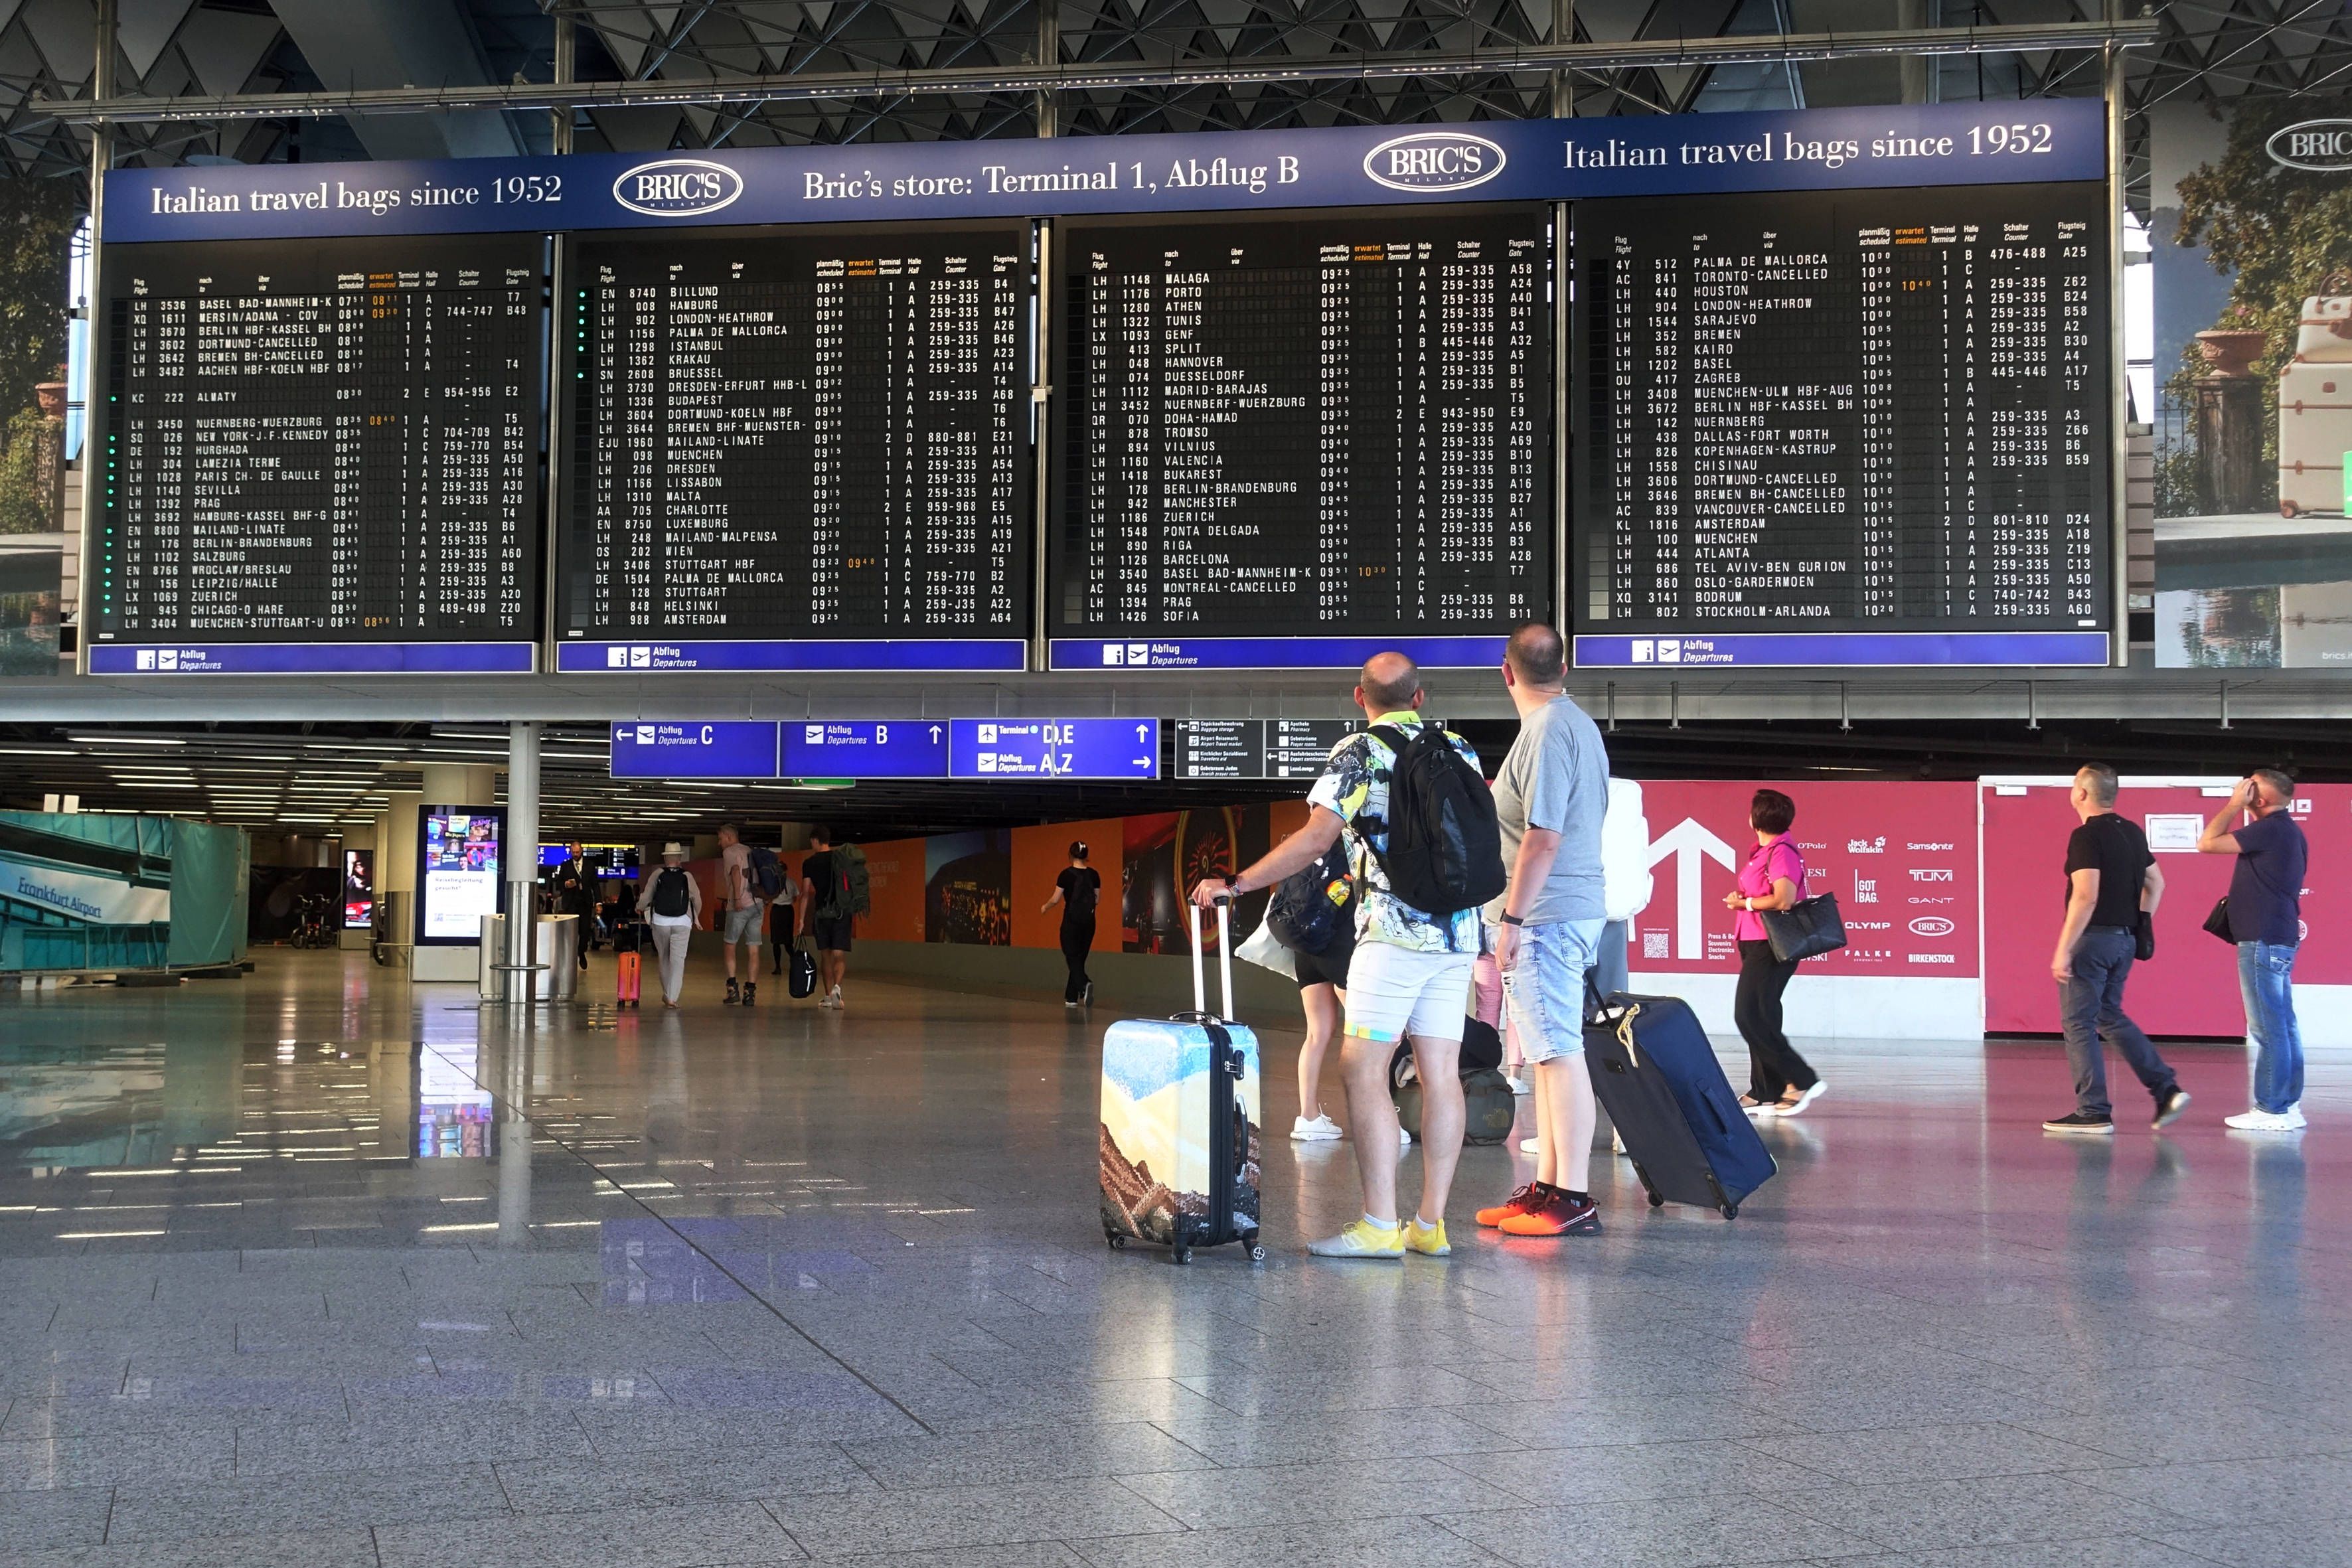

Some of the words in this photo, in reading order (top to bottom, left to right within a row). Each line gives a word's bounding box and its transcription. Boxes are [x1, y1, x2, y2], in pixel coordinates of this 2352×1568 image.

[1563, 139, 1667, 169] Italian
[1679, 132, 1774, 165] travel
[1784, 131, 1859, 169] bags
[1872, 130, 1953, 158] since
[1967, 123, 2052, 155] 1952
[2289, 132, 2352, 157] BRIC
[1388, 146, 1482, 176] BRIC'S
[894, 175, 972, 196] store:
[982, 161, 1118, 193] Terminal
[1131, 161, 1156, 195] 1,
[1164, 157, 1268, 194] Abflug
[1277, 156, 1299, 183] B
[1403, 175, 1466, 184] MILANO
[635, 172, 721, 200] BRIC'S
[151, 187, 241, 214] Italian
[249, 182, 329, 211] travel
[337, 181, 400, 216] bags
[410, 181, 479, 206] since
[492, 175, 562, 203] 1952
[1091, 252, 1105, 262] Flug
[1230, 248, 1245, 257] über
[1320, 244, 1350, 256] planmäßig
[1354, 244, 1381, 253] erwartet
[1386, 242, 1411, 252] Terminal
[1417, 242, 1433, 252] Halle
[1456, 240, 1482, 250] Schalter
[1508, 238, 1535, 250] Flugsteig
[1092, 261, 1109, 271] Flight
[1320, 254, 1350, 264] scheduled
[1354, 253, 1385, 263] estimated
[1386, 252, 1411, 261] Terminal
[1417, 251, 1431, 261] Hall
[1456, 250, 1481, 260] Counter
[1508, 248, 1523, 258] Gate
[1093, 275, 1107, 286] LH
[1123, 274, 1150, 285] 1148
[1166, 273, 1210, 284] MALAGA
[1442, 264, 1494, 276] 259-335
[1510, 263, 1532, 274] A58
[1694, 268, 1828, 283] TORONTO-CANCELLED
[601, 289, 615, 299] EN
[629, 287, 656, 298] 8740
[670, 286, 718, 297] BILLUND
[930, 279, 979, 290] 259-335
[994, 279, 1008, 289] B4
[1616, 288, 1630, 299] LH
[1655, 287, 1677, 298] 440
[1694, 285, 1748, 297] HOUSTON
[1990, 277, 2046, 289] 259-335
[2063, 275, 2086, 287] Z62
[134, 314, 147, 325] XQ
[161, 313, 185, 324] 1611
[199, 311, 279, 323] MERSIN/ADANA
[447, 305, 493, 317] 744-747
[507, 305, 526, 315] B48
[670, 311, 773, 325] LONDON-HEATHROW
[1694, 313, 1757, 326] SARAJEVO
[668, 354, 710, 364] KRAKAU
[1165, 356, 1223, 368] HANNOVER
[1164, 370, 1245, 382] DUESSELDORF
[1694, 372, 1741, 384] ZAGREB
[197, 392, 237, 402] ALMATY
[1164, 397, 1305, 410] NUERNBERF-WUERZBURG
[196, 445, 248, 455] HURGHADA
[1695, 443, 1836, 457] KOPENHAGEN-KASTRUP
[666, 463, 715, 474] DRESDEN
[1695, 459, 1757, 471] CHISINAU
[1164, 469, 1222, 480] BUKAREST
[195, 485, 240, 495] SEVILLA
[666, 504, 728, 516] CHARLOTTE
[193, 524, 285, 535] MAILAND-LINATE
[666, 518, 728, 529] LUXEMBURG
[193, 551, 246, 562] SALZBURG
[1163, 554, 1229, 565] BARCELONA
[191, 591, 238, 602] ZUERICH
[1163, 611, 1199, 621] SOFIA
[1695, 605, 1830, 617] STOCKHOLM-ARLANDA
[664, 614, 726, 625] AMSTERDAM
[1151, 643, 1180, 655] Abflug
[1683, 639, 1714, 652] Abflug
[180, 649, 206, 661] Abflug
[653, 646, 680, 658] Abflug
[1683, 652, 1734, 664] Departures
[179, 661, 222, 672] Departures
[653, 658, 697, 668] Departures
[1151, 655, 1198, 666] Departures
[658, 726, 682, 736] Abflug
[701, 725, 713, 745] C
[827, 725, 852, 736] Abflug
[876, 725, 888, 744] B
[998, 725, 1029, 734] Terminal
[658, 736, 698, 746] Departures
[827, 736, 868, 746] Departures
[998, 753, 1022, 764] Abflug
[998, 763, 1036, 773] Departures
[1847, 839, 1868, 848] Jack
[1807, 868, 1827, 877] ESI
[1909, 870, 1953, 882] TUMI
[1859, 880, 1876, 892] GOT
[17, 876, 70, 910] Frankfurt
[71, 897, 102, 919] Airport
[1859, 892, 1879, 903] BAG.
[1918, 922, 1946, 931] BRIC'S
[1908, 954, 1955, 963] BIRKENSTOCK
